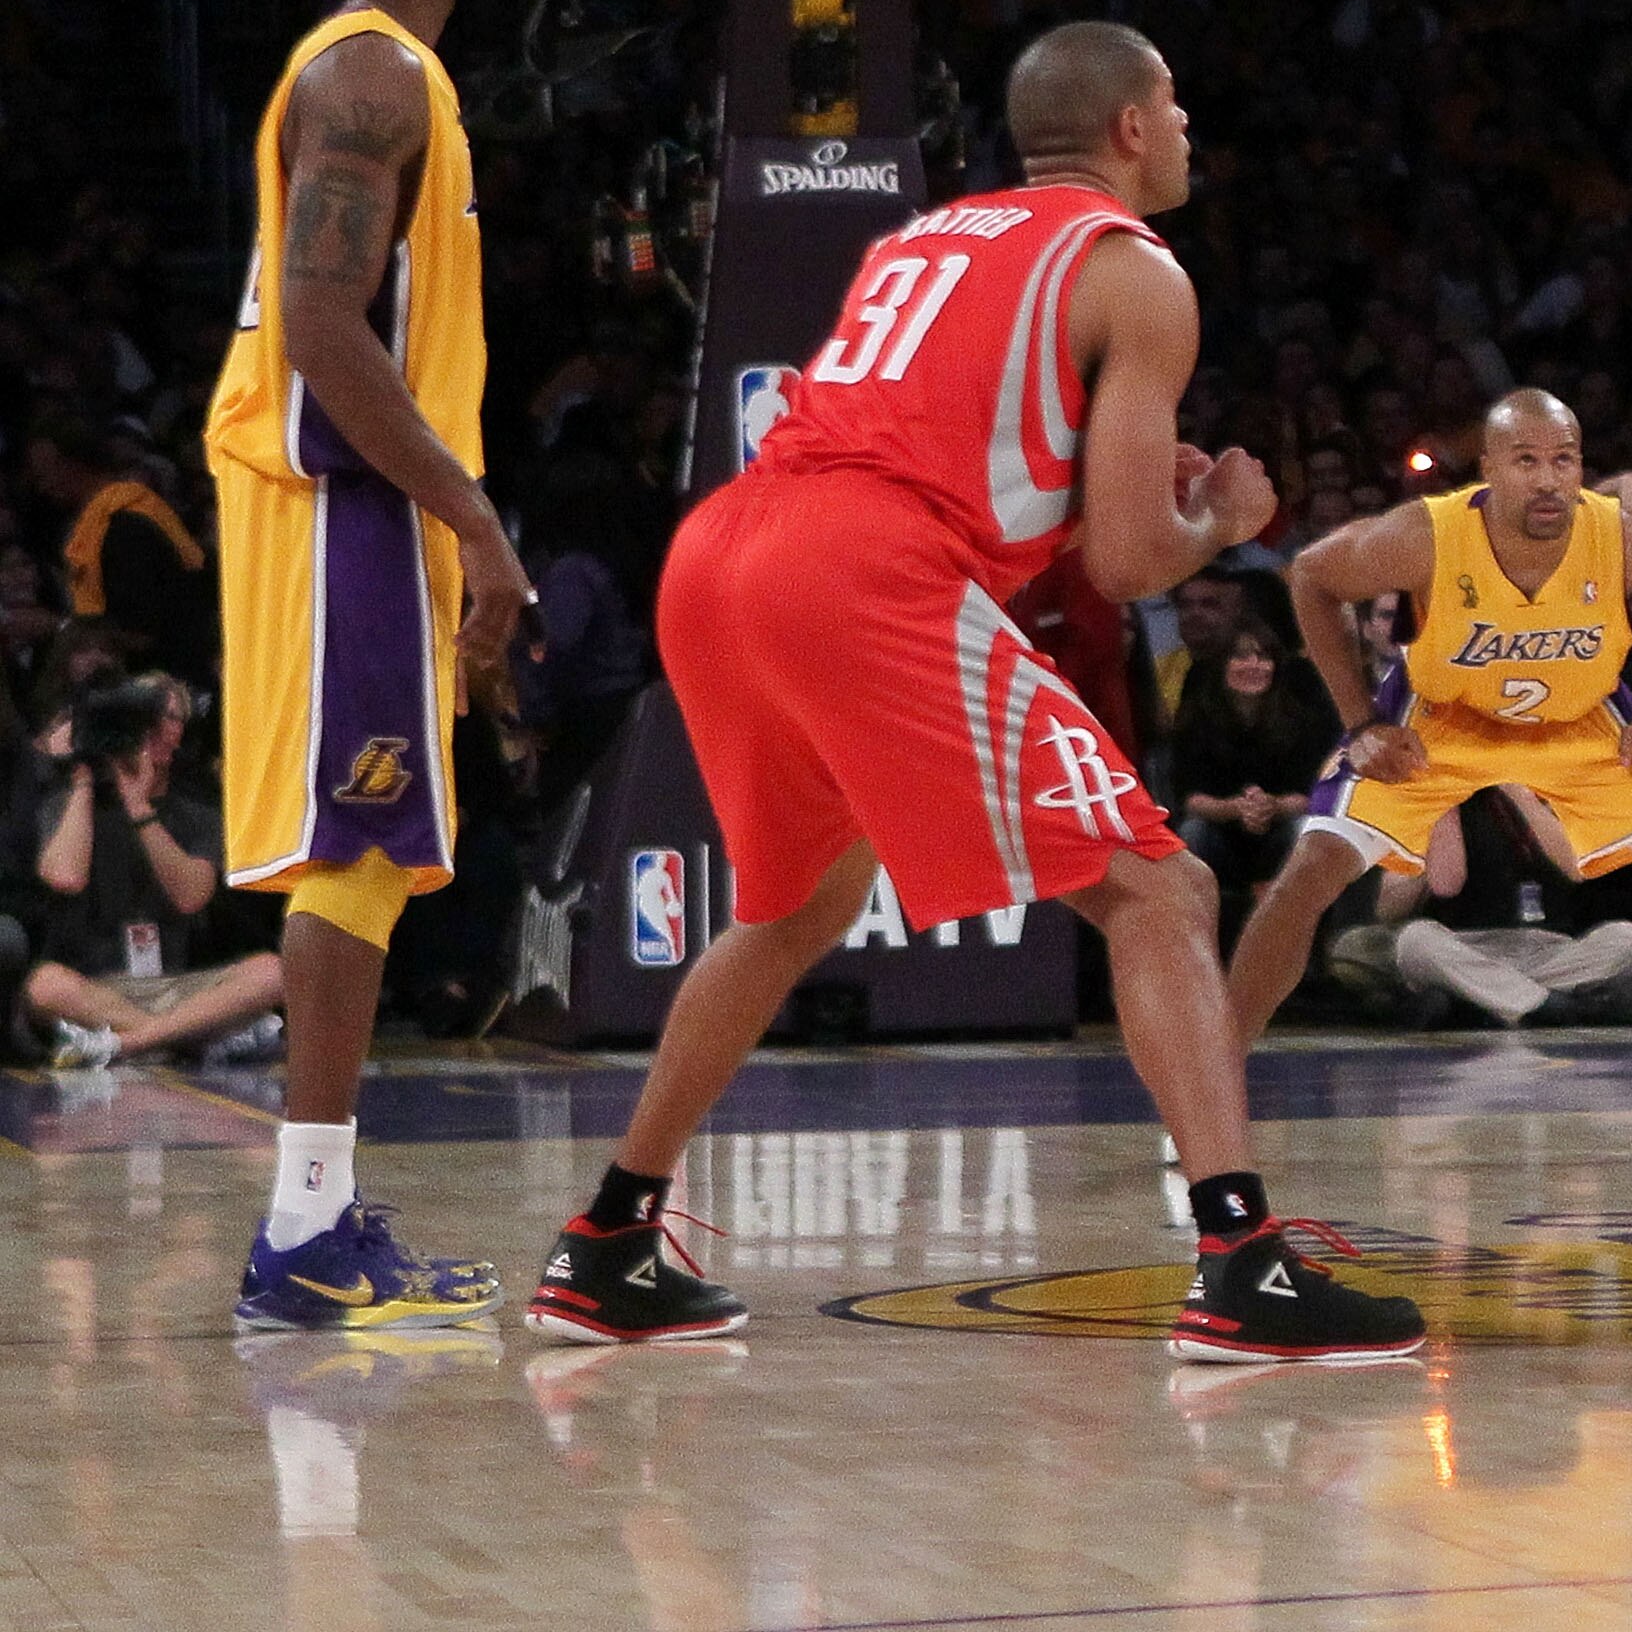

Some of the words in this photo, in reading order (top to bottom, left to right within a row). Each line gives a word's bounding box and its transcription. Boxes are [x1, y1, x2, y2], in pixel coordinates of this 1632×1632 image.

[762, 162, 899, 195] SPALDING
[813, 253, 971, 385] 31
[1448, 620, 1607, 668] LAKERS
[1495, 677, 1551, 725] 2
